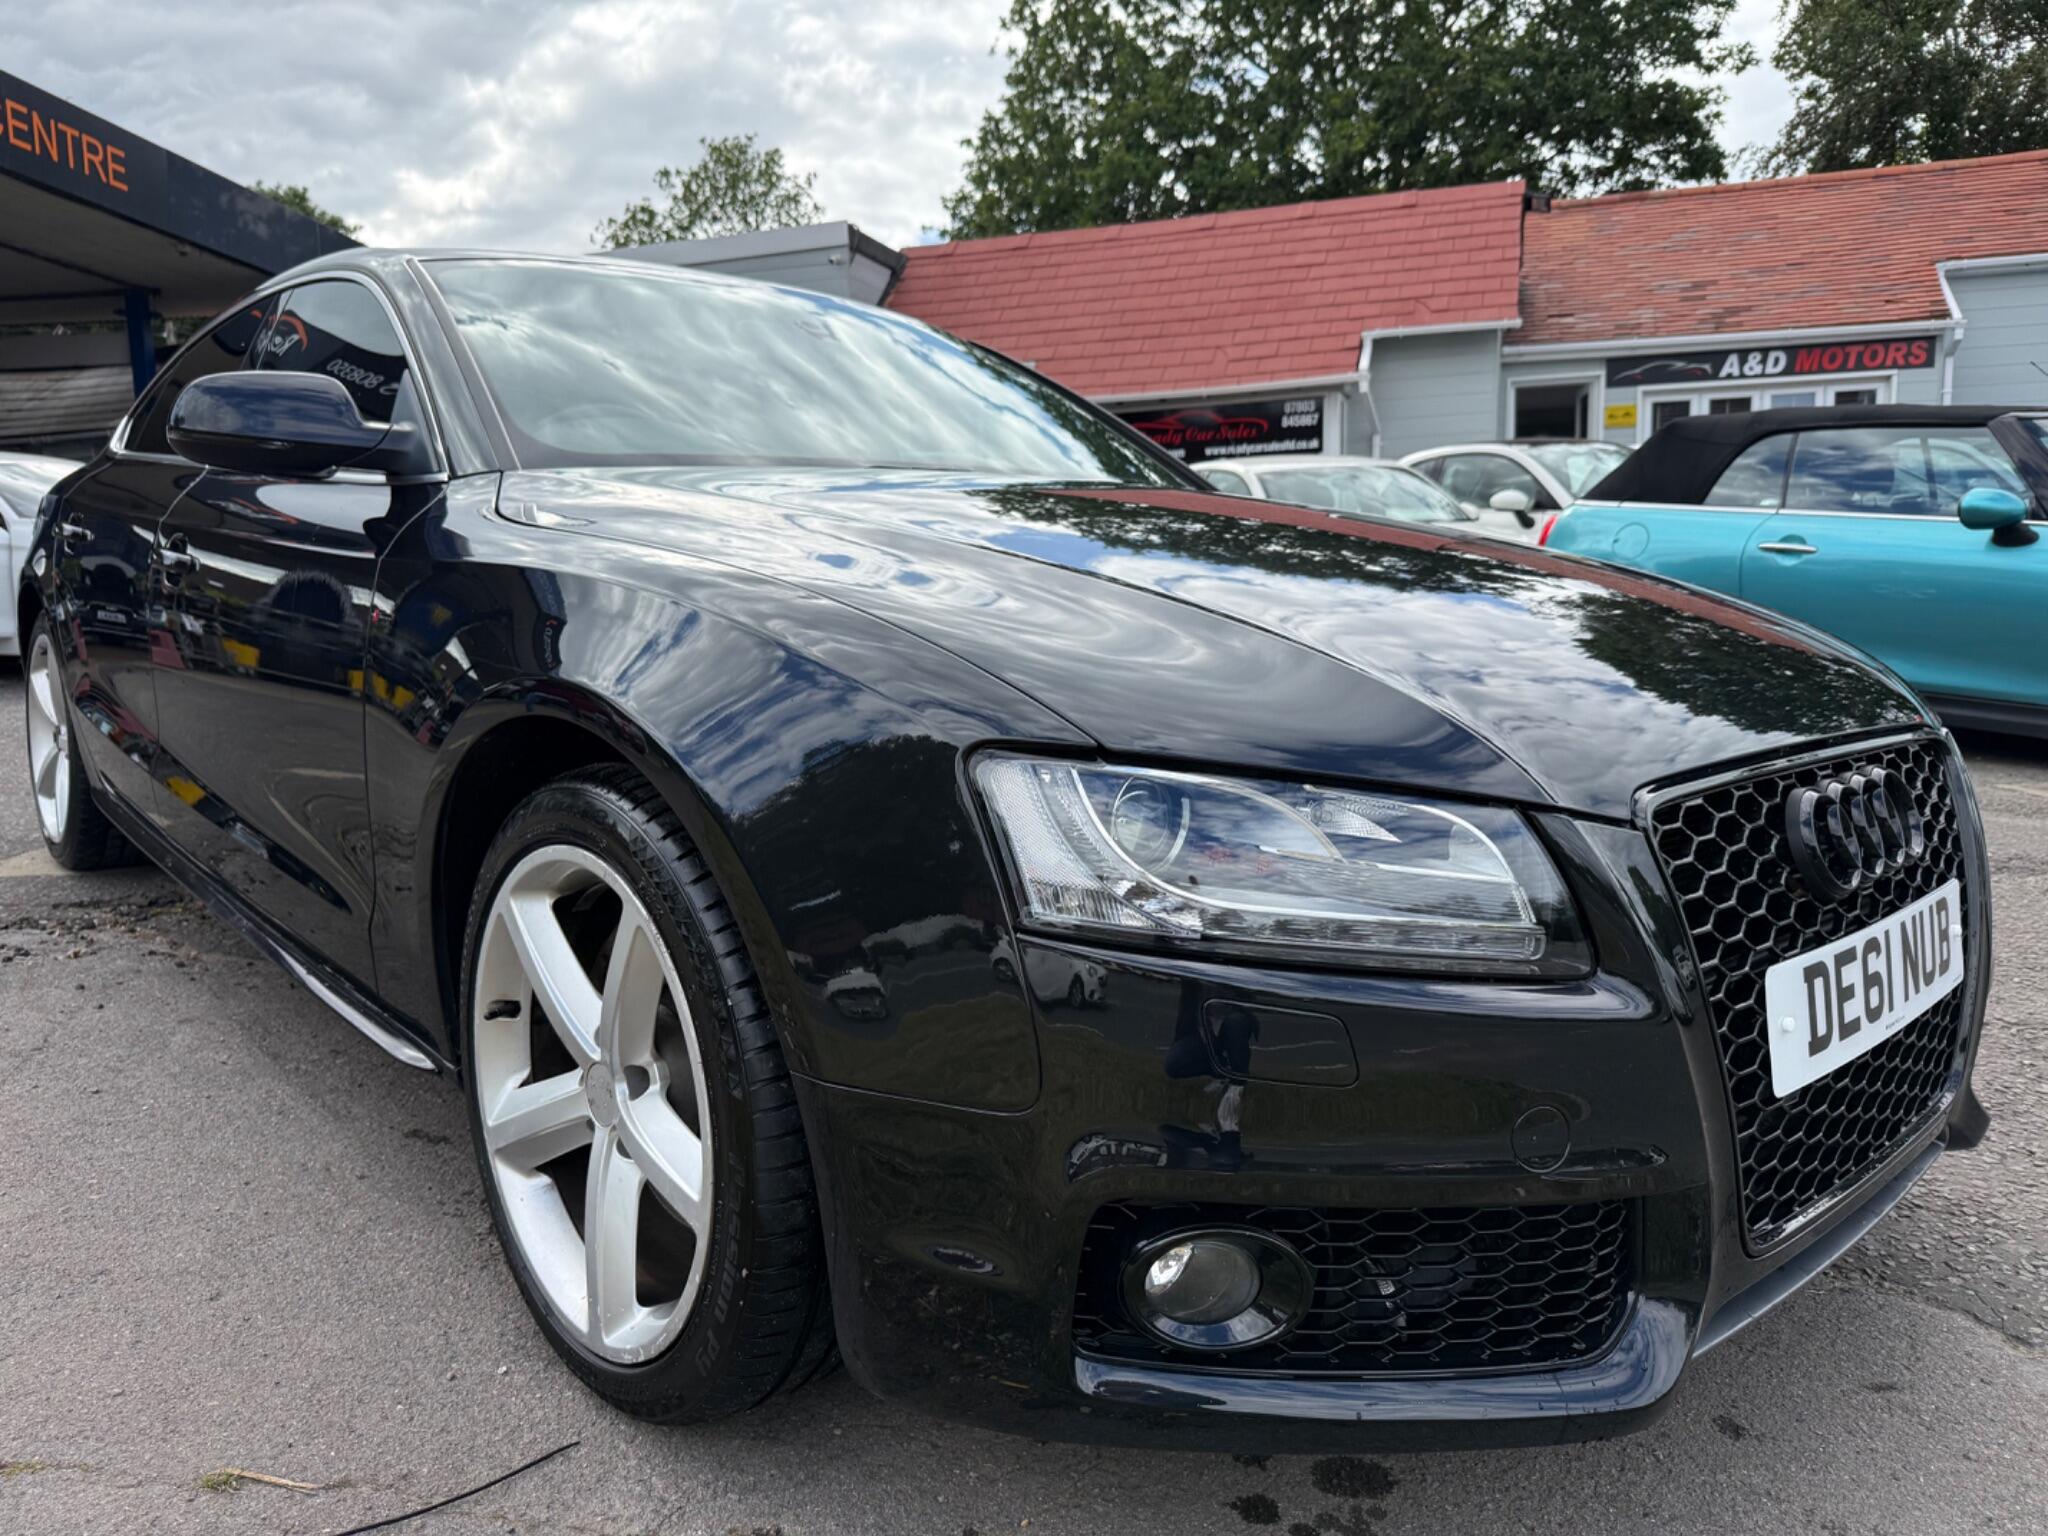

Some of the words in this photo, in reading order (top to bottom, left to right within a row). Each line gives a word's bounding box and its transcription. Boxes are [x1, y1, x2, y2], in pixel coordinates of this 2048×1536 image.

[1718, 350, 1786, 378] A&D
[1795, 341, 1928, 372] MOTORS
[1215, 423, 1259, 440] Sales
[1803, 929, 1893, 1057] DE61
[1900, 897, 1951, 1003] NUB
